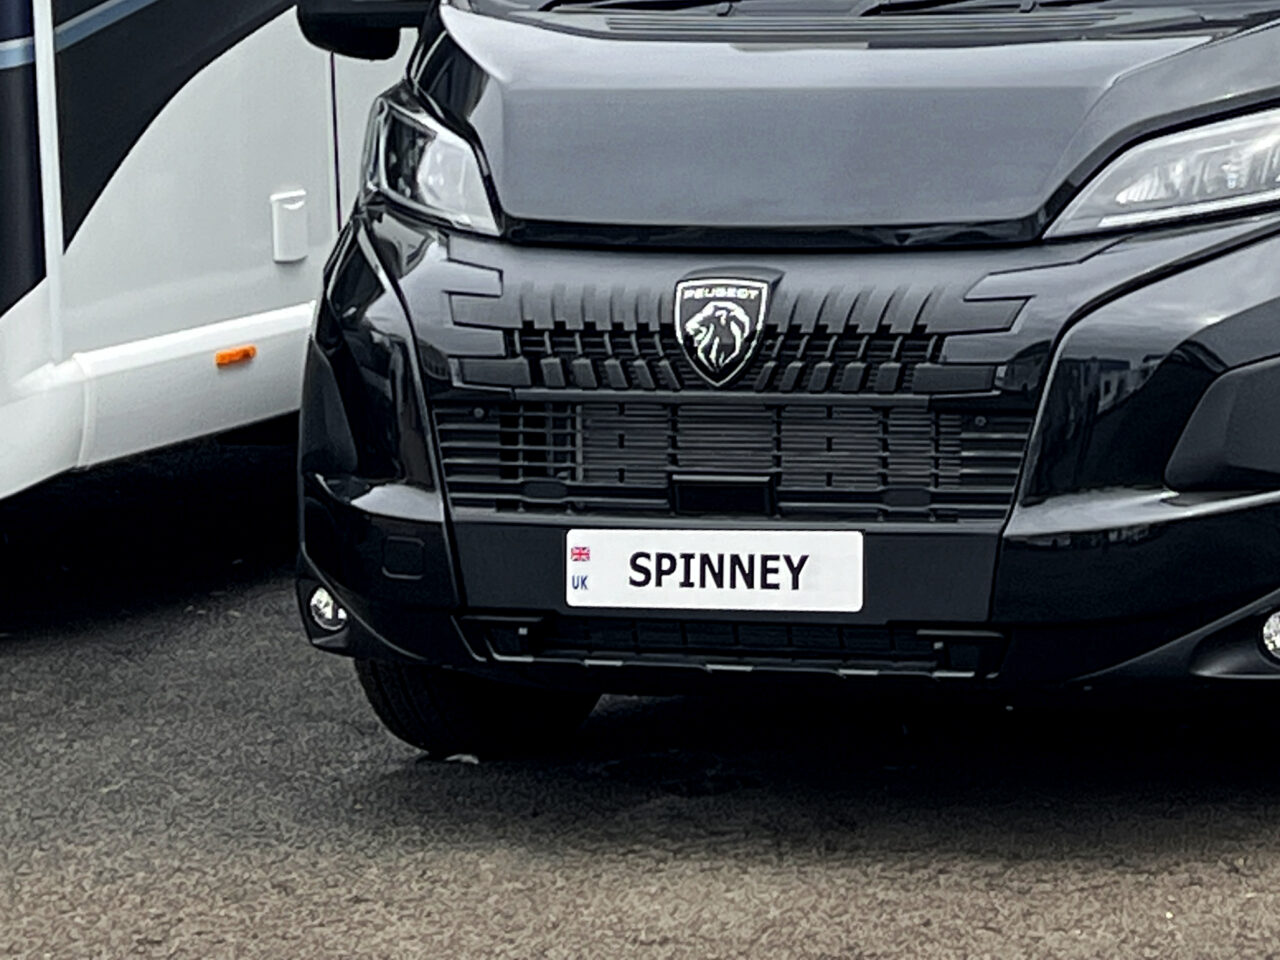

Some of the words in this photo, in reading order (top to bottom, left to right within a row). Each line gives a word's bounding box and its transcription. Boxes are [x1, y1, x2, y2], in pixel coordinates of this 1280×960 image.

[683, 287, 760, 300] PEUGEOT
[629, 551, 809, 590] SPINNEY
[571, 575, 589, 590] UK
